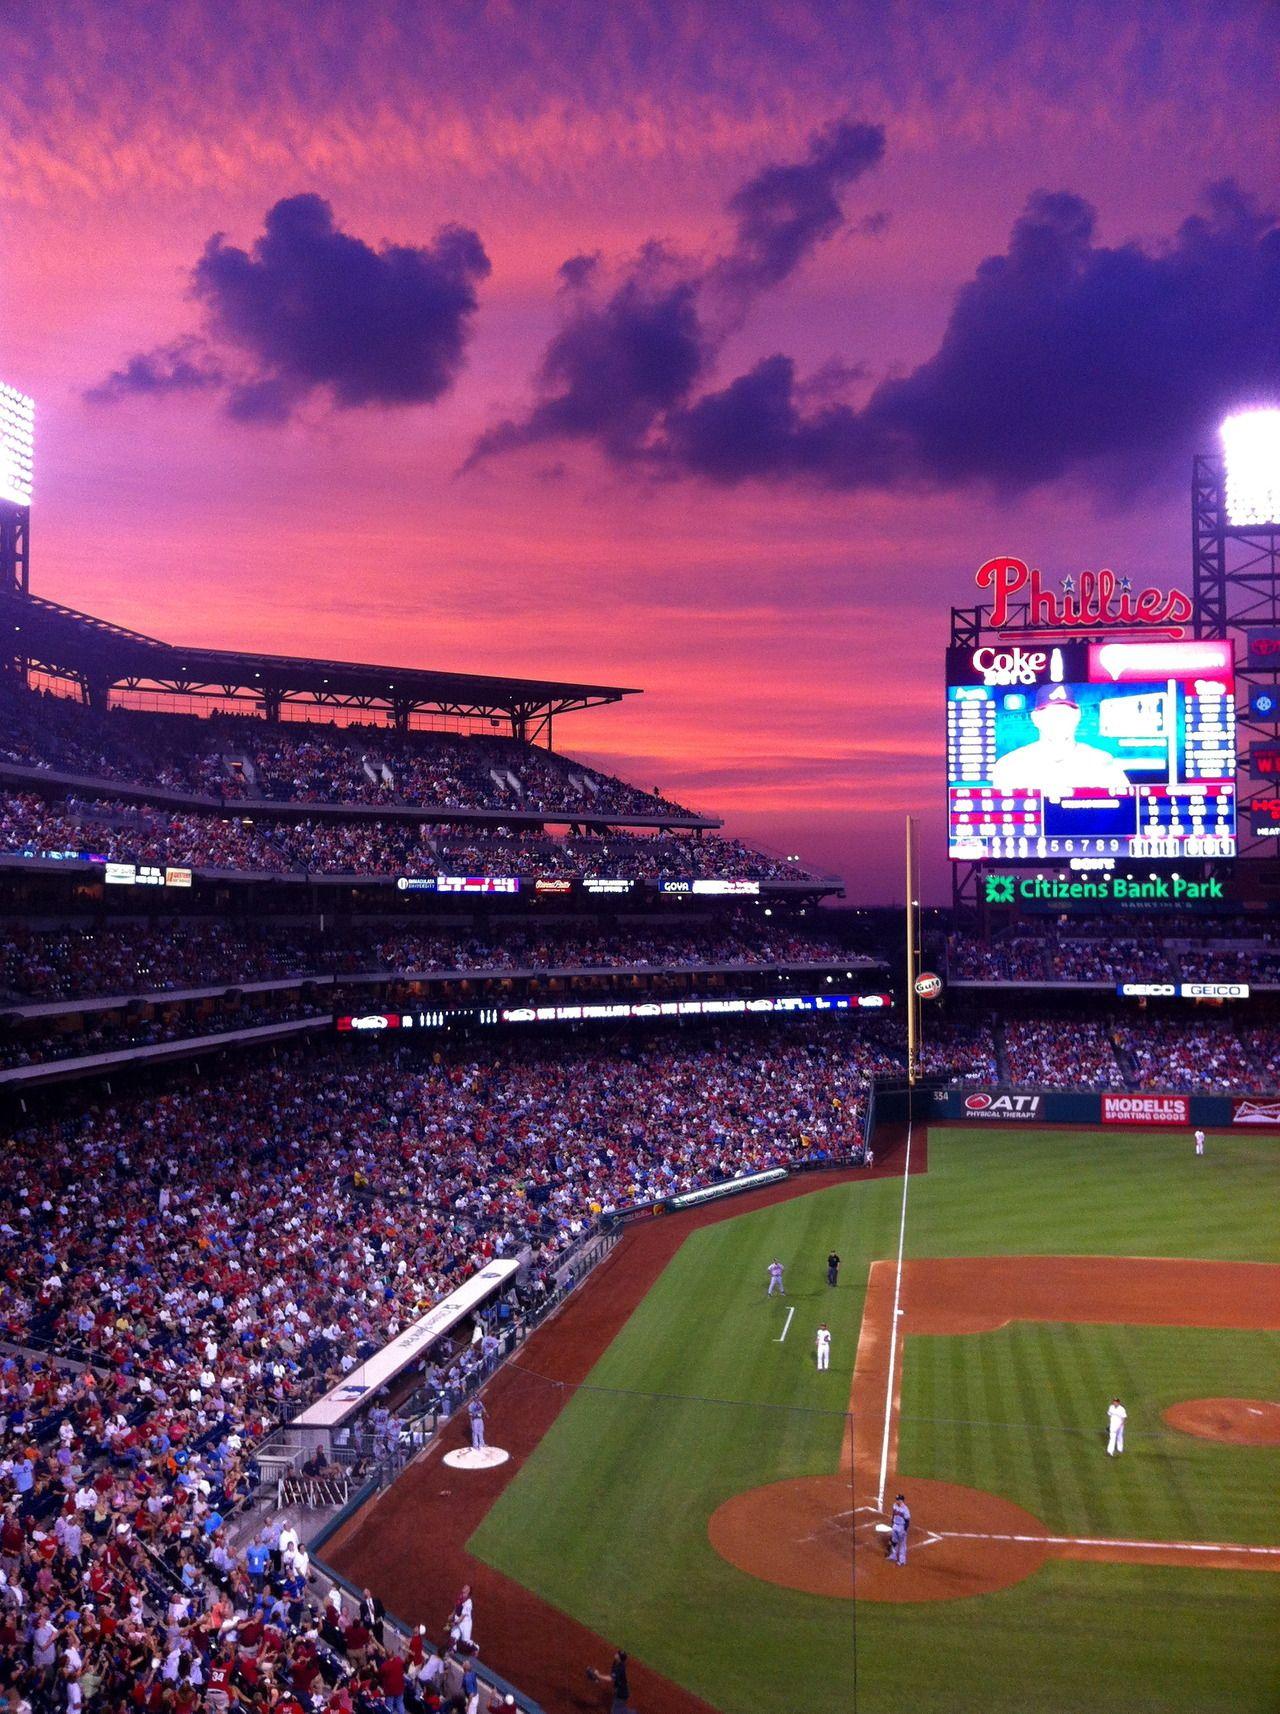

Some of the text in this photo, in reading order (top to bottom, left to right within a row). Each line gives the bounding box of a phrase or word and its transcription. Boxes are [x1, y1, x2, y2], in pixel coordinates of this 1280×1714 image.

[975, 556, 1194, 628] Phillies
[972, 647, 1047, 673] Coke
[1051, 840, 1059, 852] 5
[1064, 840, 1073, 852] 6
[1081, 840, 1090, 852] 7
[1096, 839, 1105, 852] 8
[1110, 839, 1119, 852] 9
[664, 881, 690, 892] GOYA
[1020, 877, 1223, 898] Citizens Bank Park
[916, 979, 940, 992] Gulf
[1190, 985, 1241, 996] GEICO
[989, 1095, 1040, 1111] ATI
[1104, 1098, 1186, 1114] MODELL'S
[966, 1110, 1036, 1119] PHYSICAL THERAPY
[1105, 1112, 1186, 1121] SPORTING GOODS
[211, 1671, 225, 1682] 34
